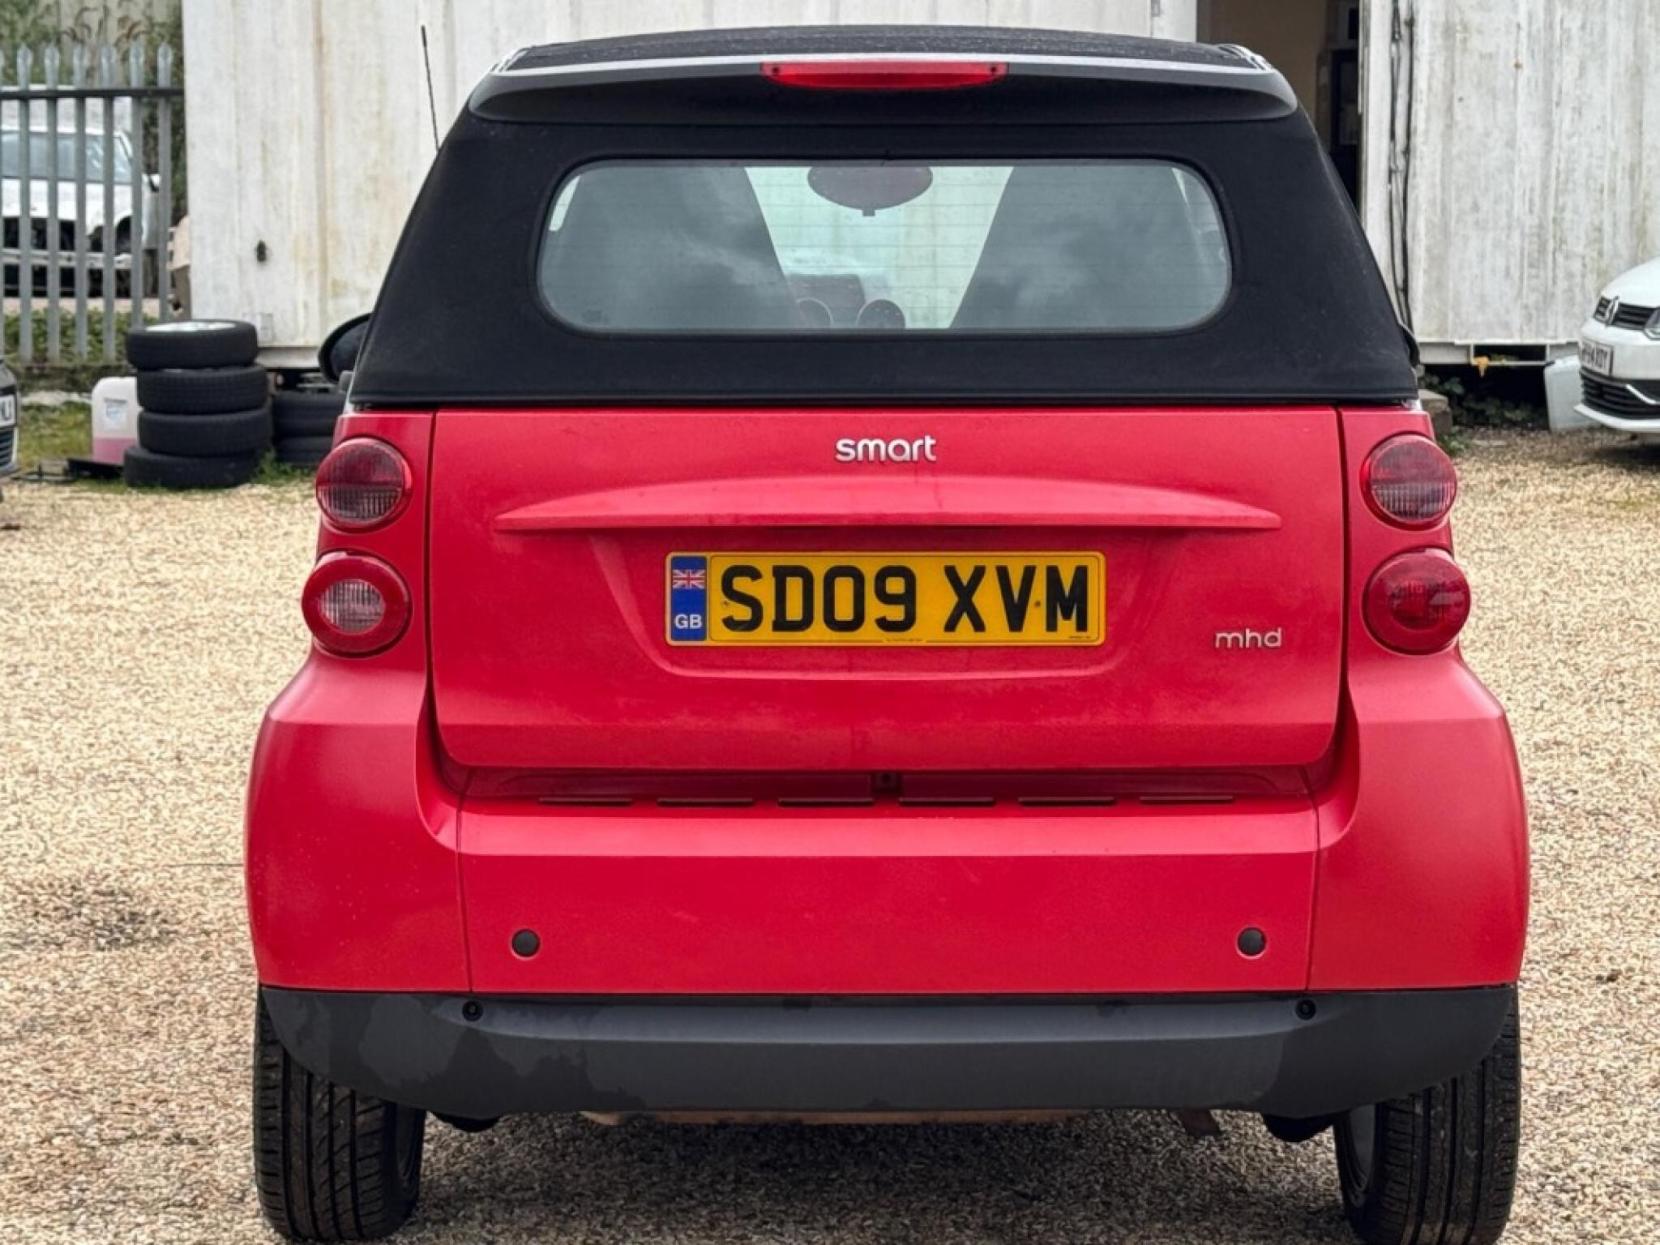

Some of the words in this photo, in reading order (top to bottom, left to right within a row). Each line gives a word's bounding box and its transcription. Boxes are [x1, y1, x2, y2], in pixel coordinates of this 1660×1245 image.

[835, 434, 937, 462] smart
[720, 564, 917, 633] SD09
[943, 564, 1089, 633] XVM
[675, 613, 702, 629] GB
[1215, 627, 1282, 649] mhd
